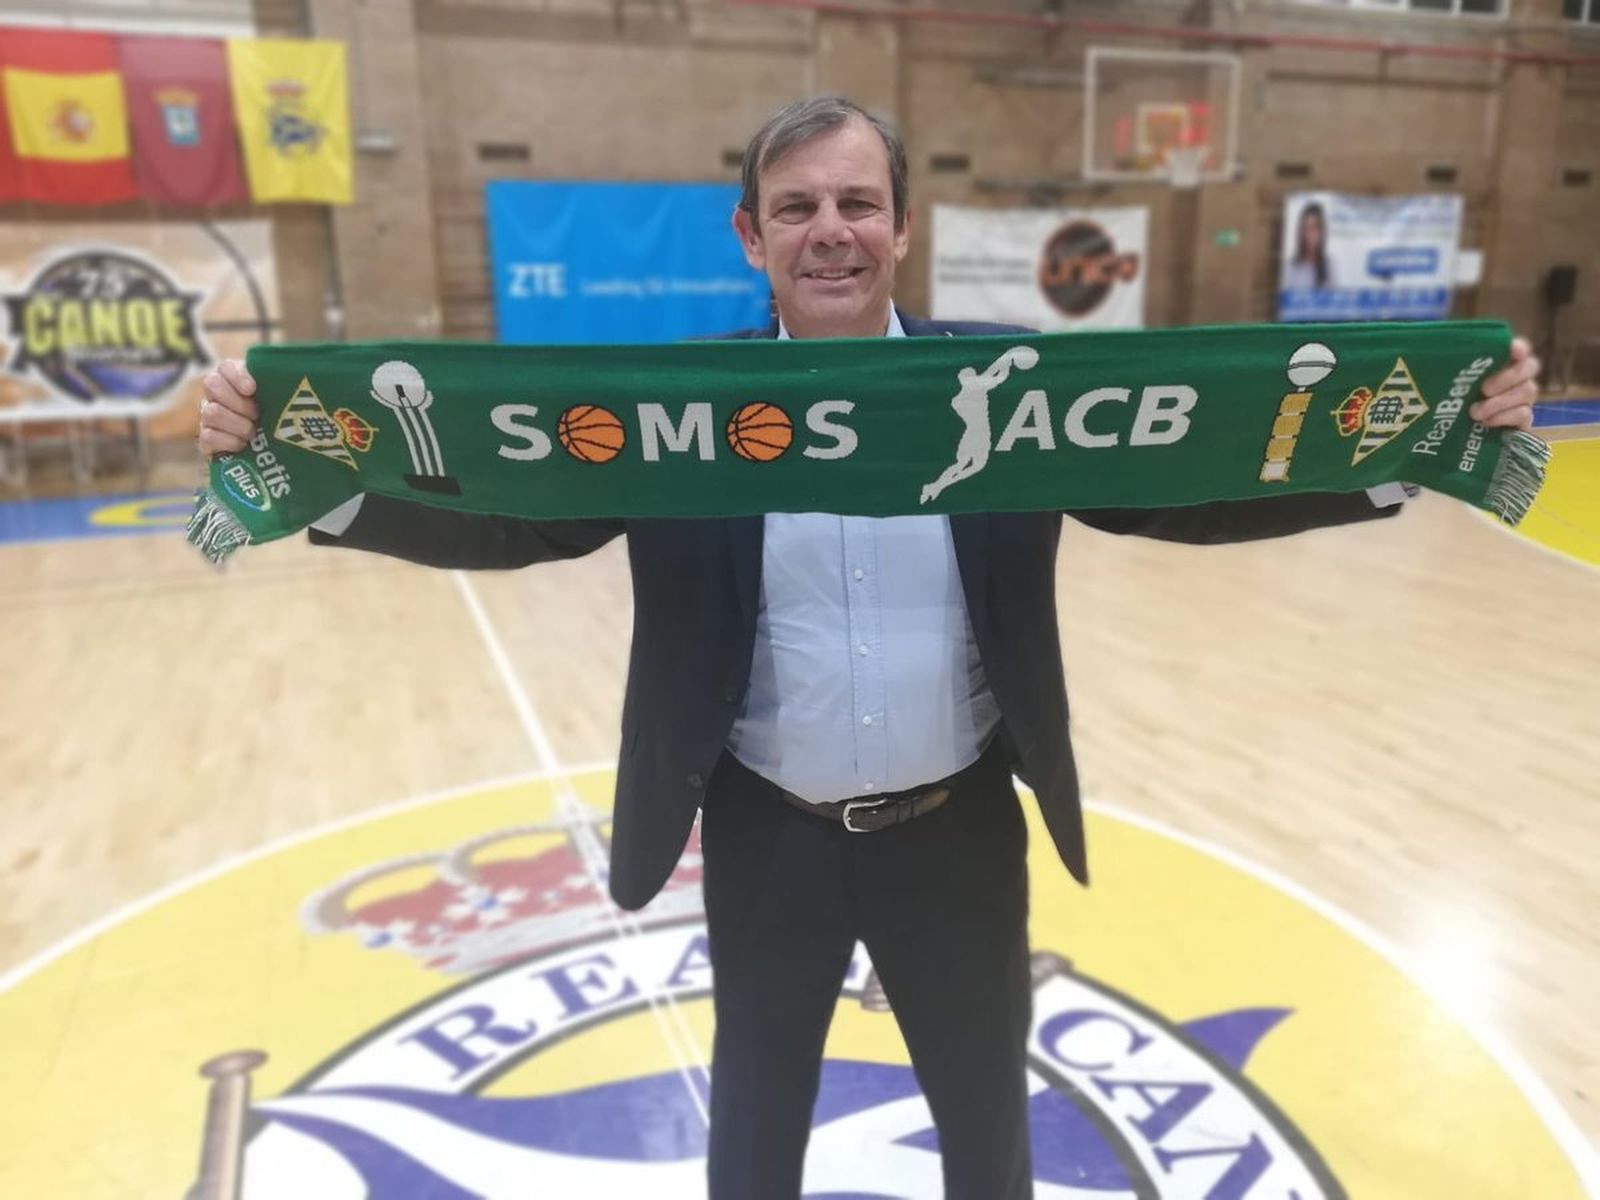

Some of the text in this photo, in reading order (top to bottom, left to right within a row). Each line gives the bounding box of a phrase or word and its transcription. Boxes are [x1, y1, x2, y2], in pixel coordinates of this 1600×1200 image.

[508, 262, 566, 297] ZTE
[23, 293, 193, 357] CANOE
[490, 399, 859, 464] SOMOS
[993, 384, 1199, 452] ACB
[224, 464, 260, 499] plus
